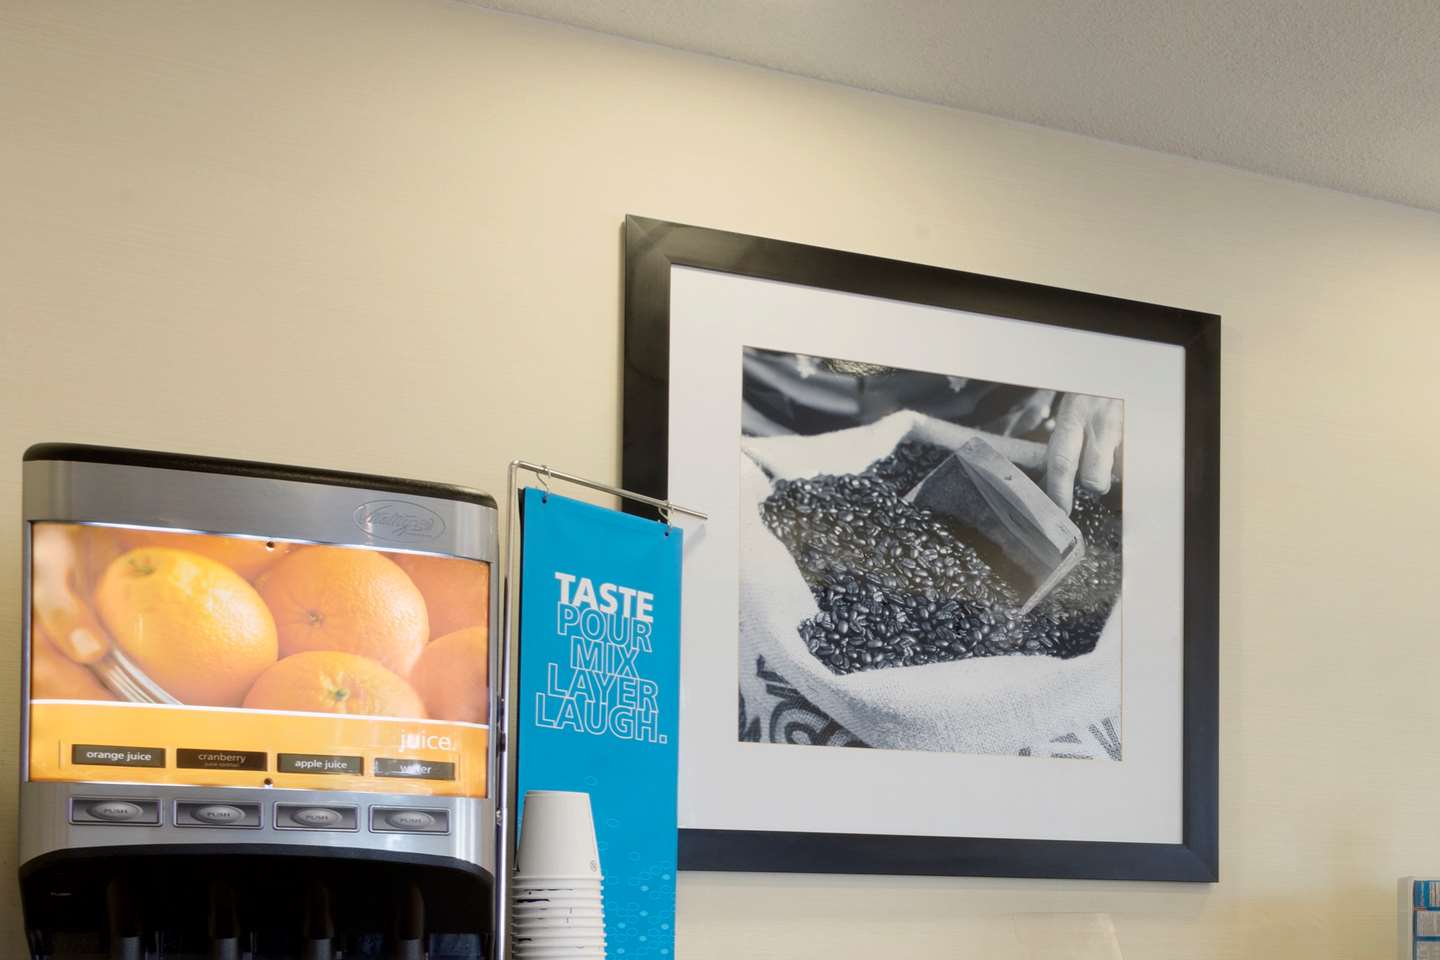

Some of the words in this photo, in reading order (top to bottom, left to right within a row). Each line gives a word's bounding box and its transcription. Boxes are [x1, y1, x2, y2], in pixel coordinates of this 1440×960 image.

[554, 571, 654, 623] TASTE
[556, 601, 653, 652] POUR
[570, 635, 640, 678] MIX
[548, 662, 659, 713] LAYER
[535, 692, 668, 744] LAUGH.
[86, 750, 125, 762] orange
[125, 751, 152, 762] juice
[400, 730, 456, 752] juice.
[198, 752, 247, 764] cranberry
[295, 760, 323, 769] apple
[324, 761, 348, 769] juice
[400, 765, 432, 774] wer
